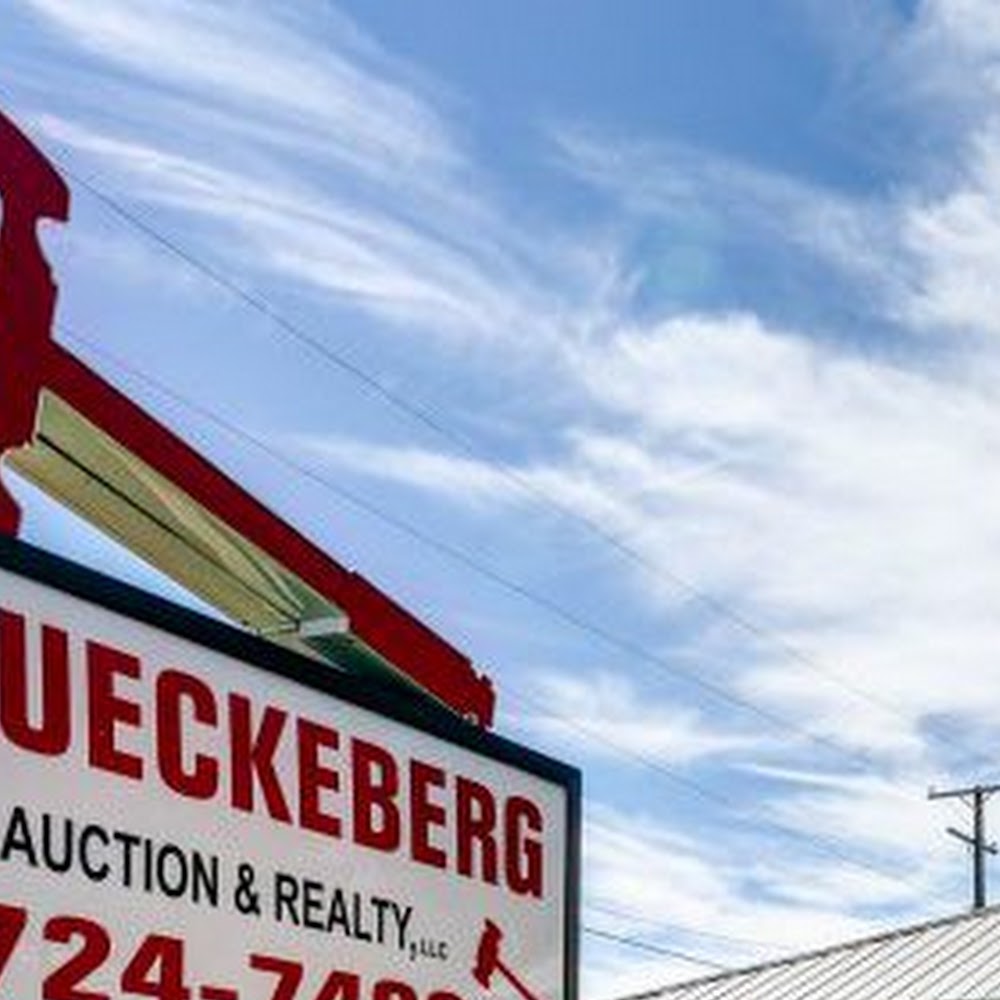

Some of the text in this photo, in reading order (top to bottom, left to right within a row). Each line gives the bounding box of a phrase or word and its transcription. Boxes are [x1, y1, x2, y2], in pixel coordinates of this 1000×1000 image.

[0, 608, 543, 897] UECKEBERG
[1, 806, 219, 906] AUCTION
[234, 863, 260, 916] &
